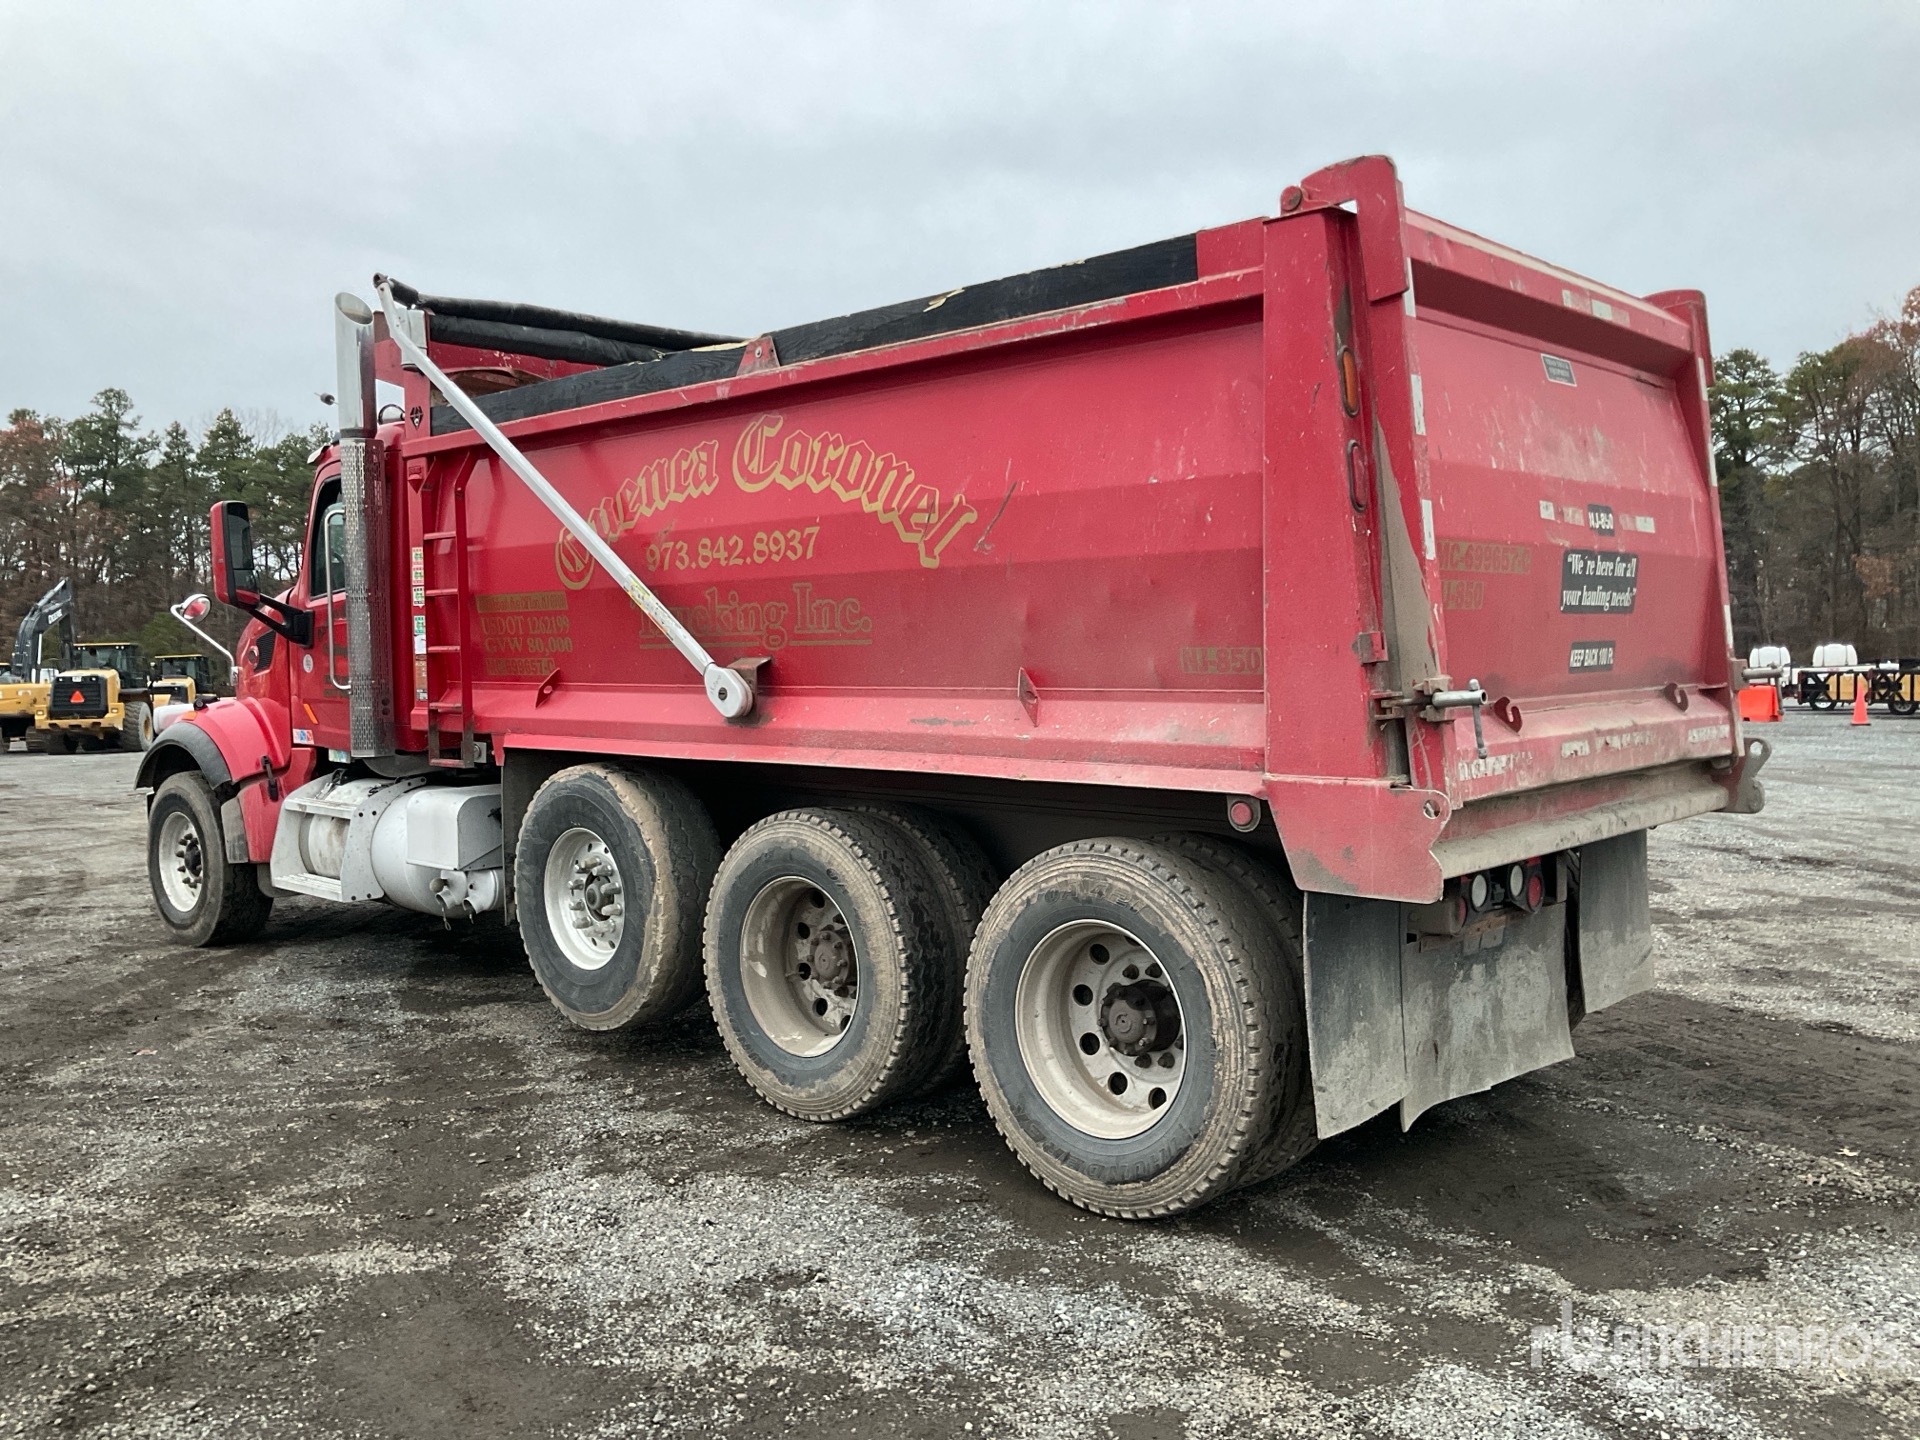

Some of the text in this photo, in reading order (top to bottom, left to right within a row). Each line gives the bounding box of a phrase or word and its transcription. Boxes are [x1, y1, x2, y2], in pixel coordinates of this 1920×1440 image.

[732, 413, 978, 569] Coronel
[646, 526, 820, 572] 973.842.8937
[1596, 555, 1613, 576] here
[1614, 557, 1626, 577] for
[793, 582, 873, 632] Inc.
[1561, 590, 1581, 611] your
[1582, 585, 1612, 611] hauling
[1570, 649, 1584, 667] KEEP
[1584, 648, 1598, 666] BACK
